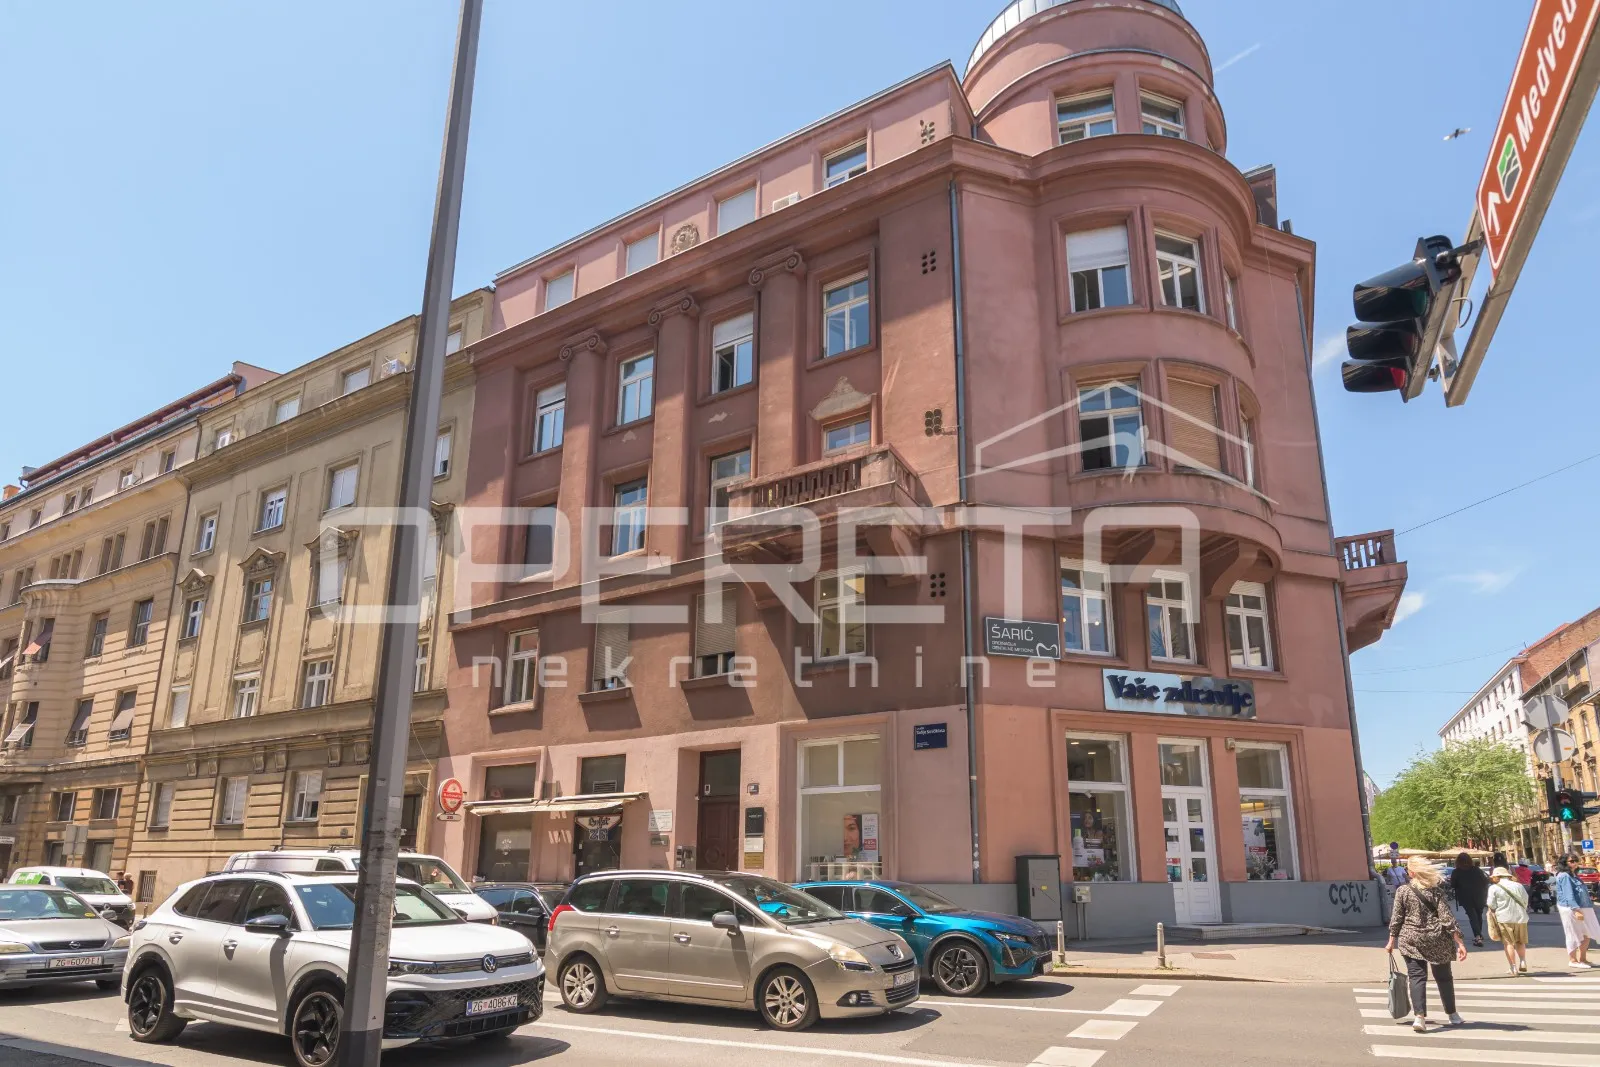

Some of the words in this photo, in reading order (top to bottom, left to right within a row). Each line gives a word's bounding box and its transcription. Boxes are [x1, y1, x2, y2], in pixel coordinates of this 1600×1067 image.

[991, 623, 1034, 641] ŠARIĆ
[1106, 674, 1160, 701] Vaše
[1162, 680, 1253, 715] zdravlje
[56, 959, 66, 967] ZG
[472, 1001, 483, 1012] ZG
